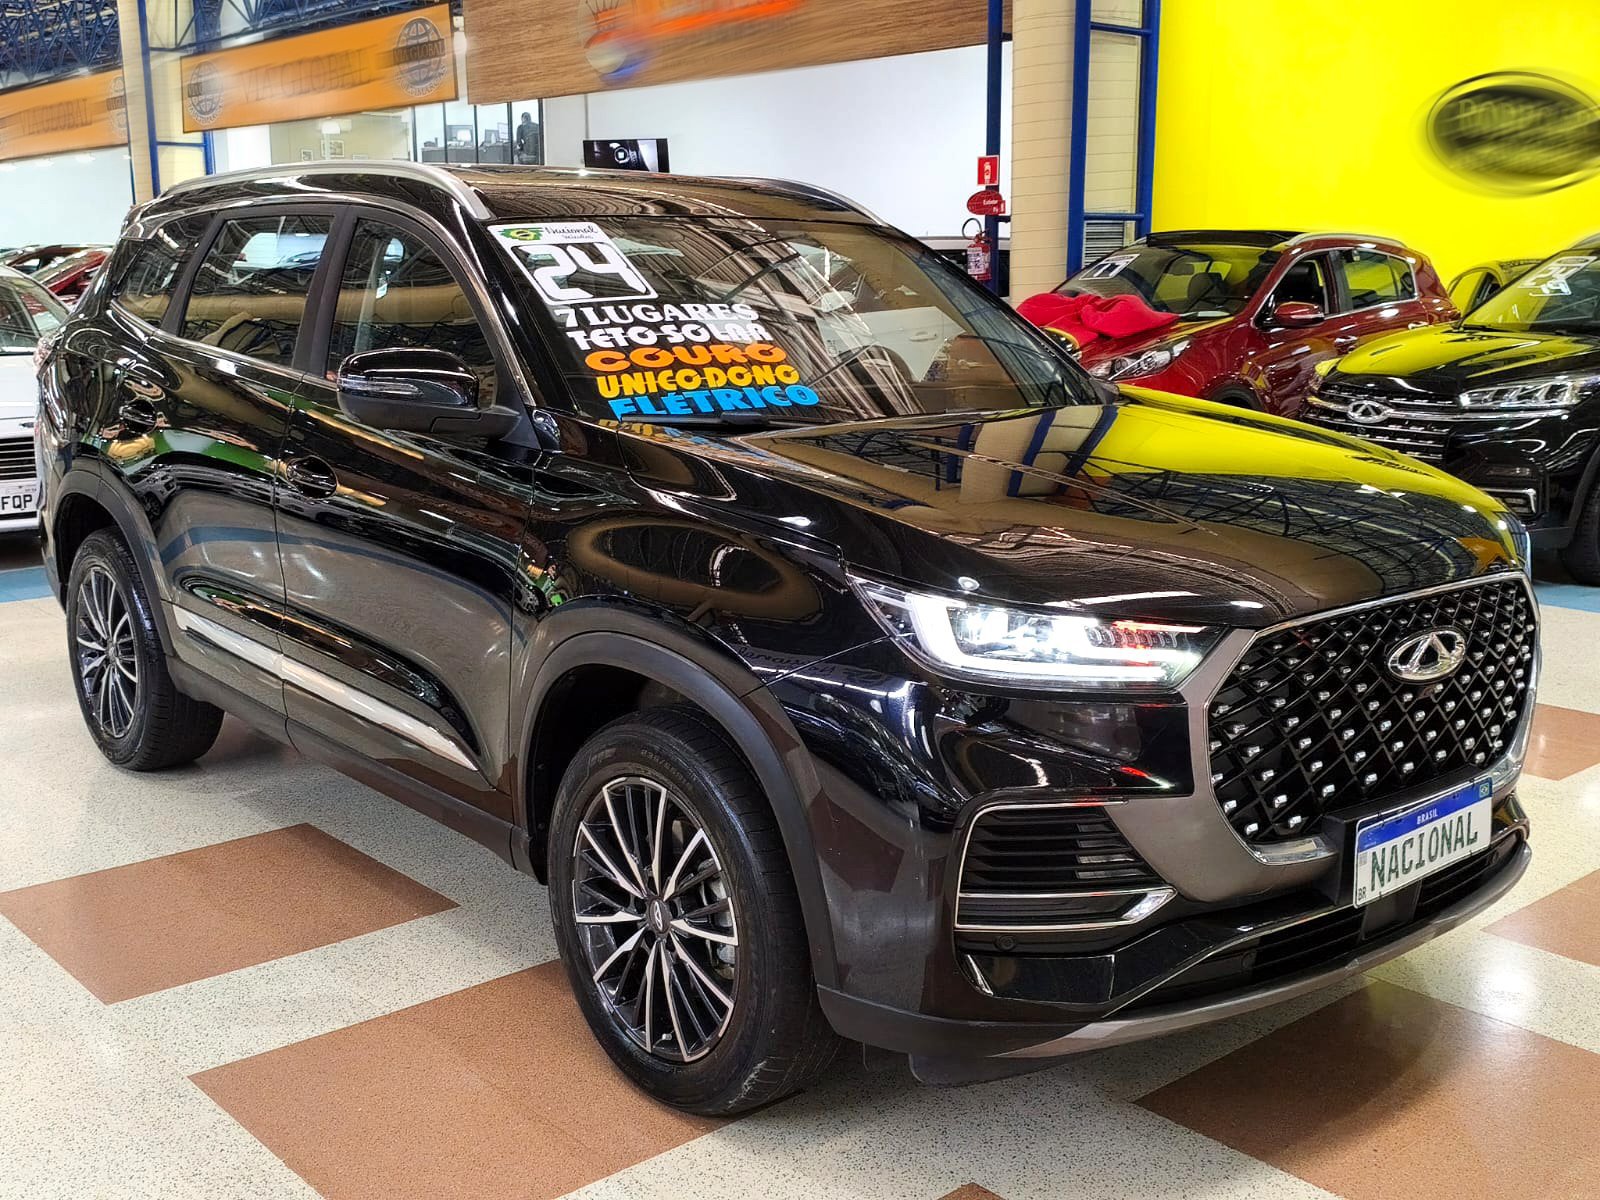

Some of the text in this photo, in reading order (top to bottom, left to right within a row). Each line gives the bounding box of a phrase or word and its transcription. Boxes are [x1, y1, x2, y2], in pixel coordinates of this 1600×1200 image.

[517, 242, 648, 300] 24
[553, 303, 760, 328] 7 LUGARES
[565, 322, 774, 351] TETO SOLAR
[585, 343, 788, 372] COURO
[596, 364, 801, 399] UNICO DONO
[1, 494, 33, 511] FQP
[1416, 808, 1438, 825] BRASIL
[1370, 811, 1478, 891] NACIONAL
[1358, 886, 1367, 901] BR
